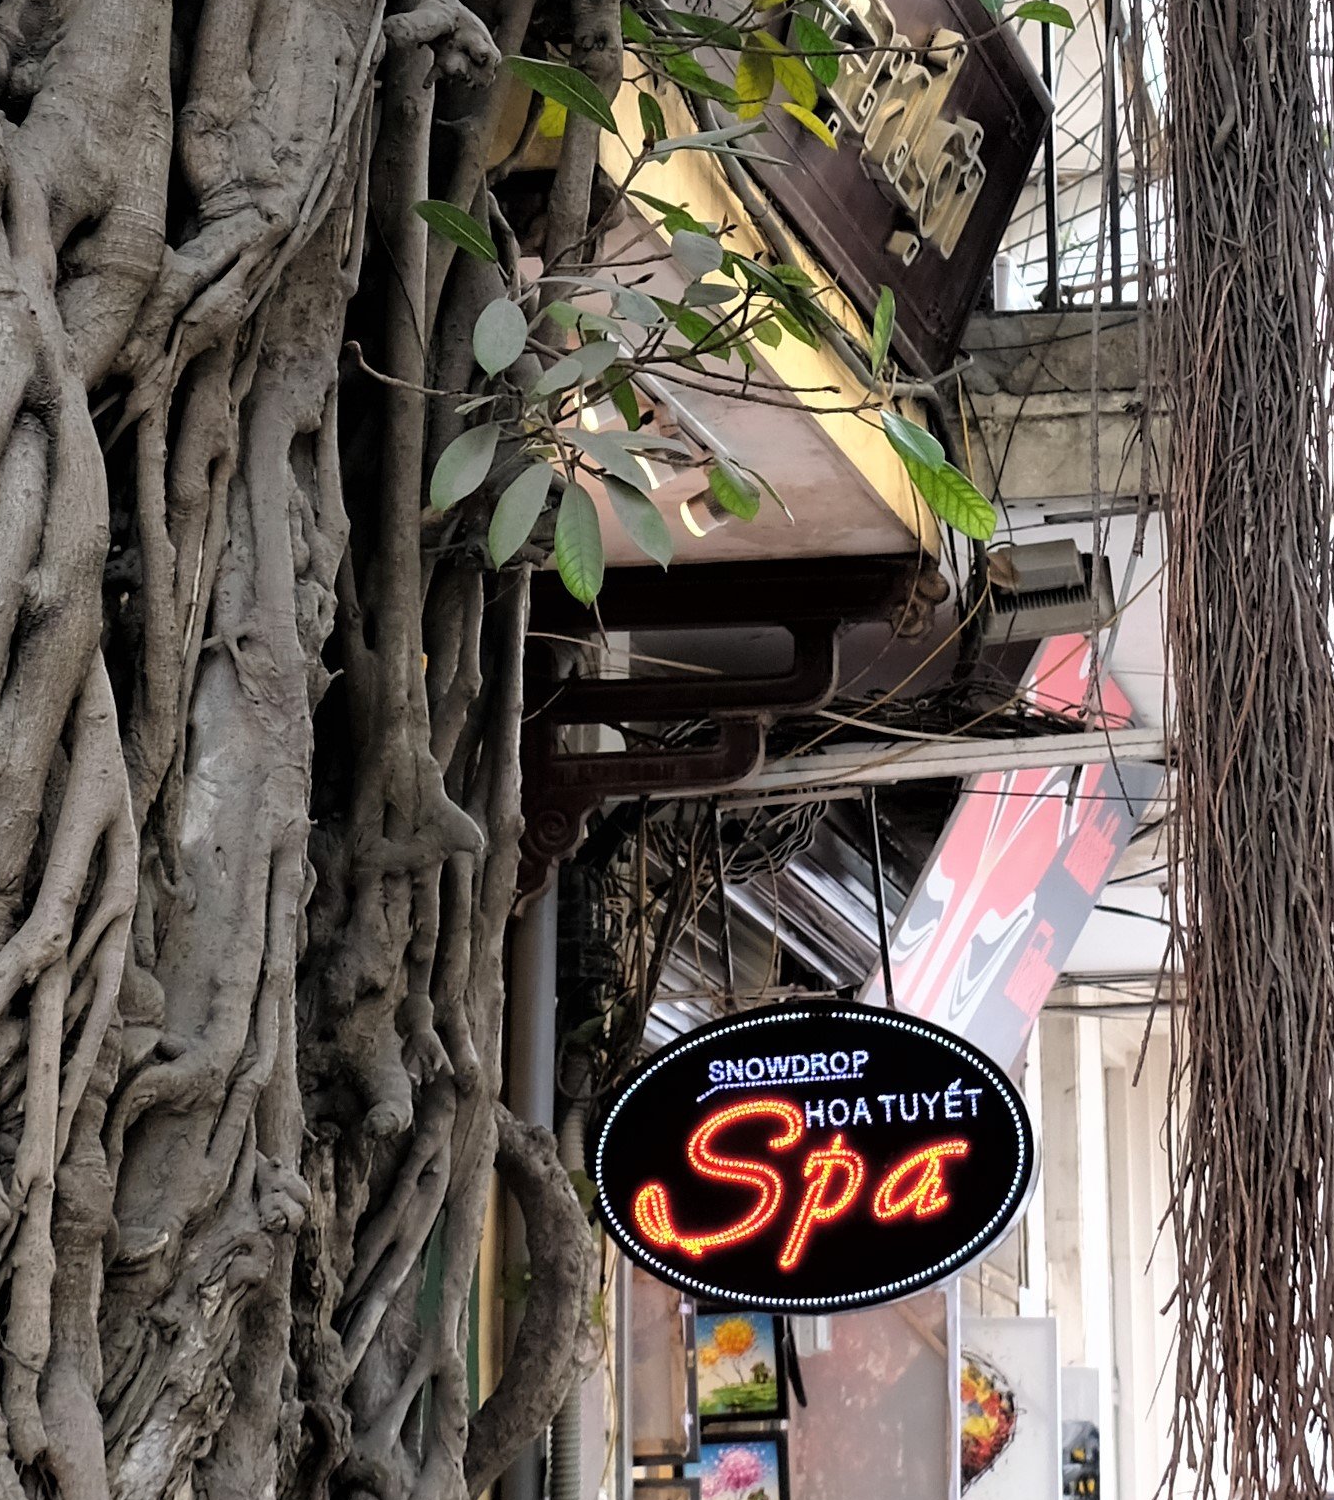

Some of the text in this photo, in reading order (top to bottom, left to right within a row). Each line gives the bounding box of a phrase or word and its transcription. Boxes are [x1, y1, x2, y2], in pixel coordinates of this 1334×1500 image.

[708, 1050, 869, 1082] SNOWDROP
[805, 1098, 873, 1128] HOA
[634, 1100, 970, 1272] Spa
